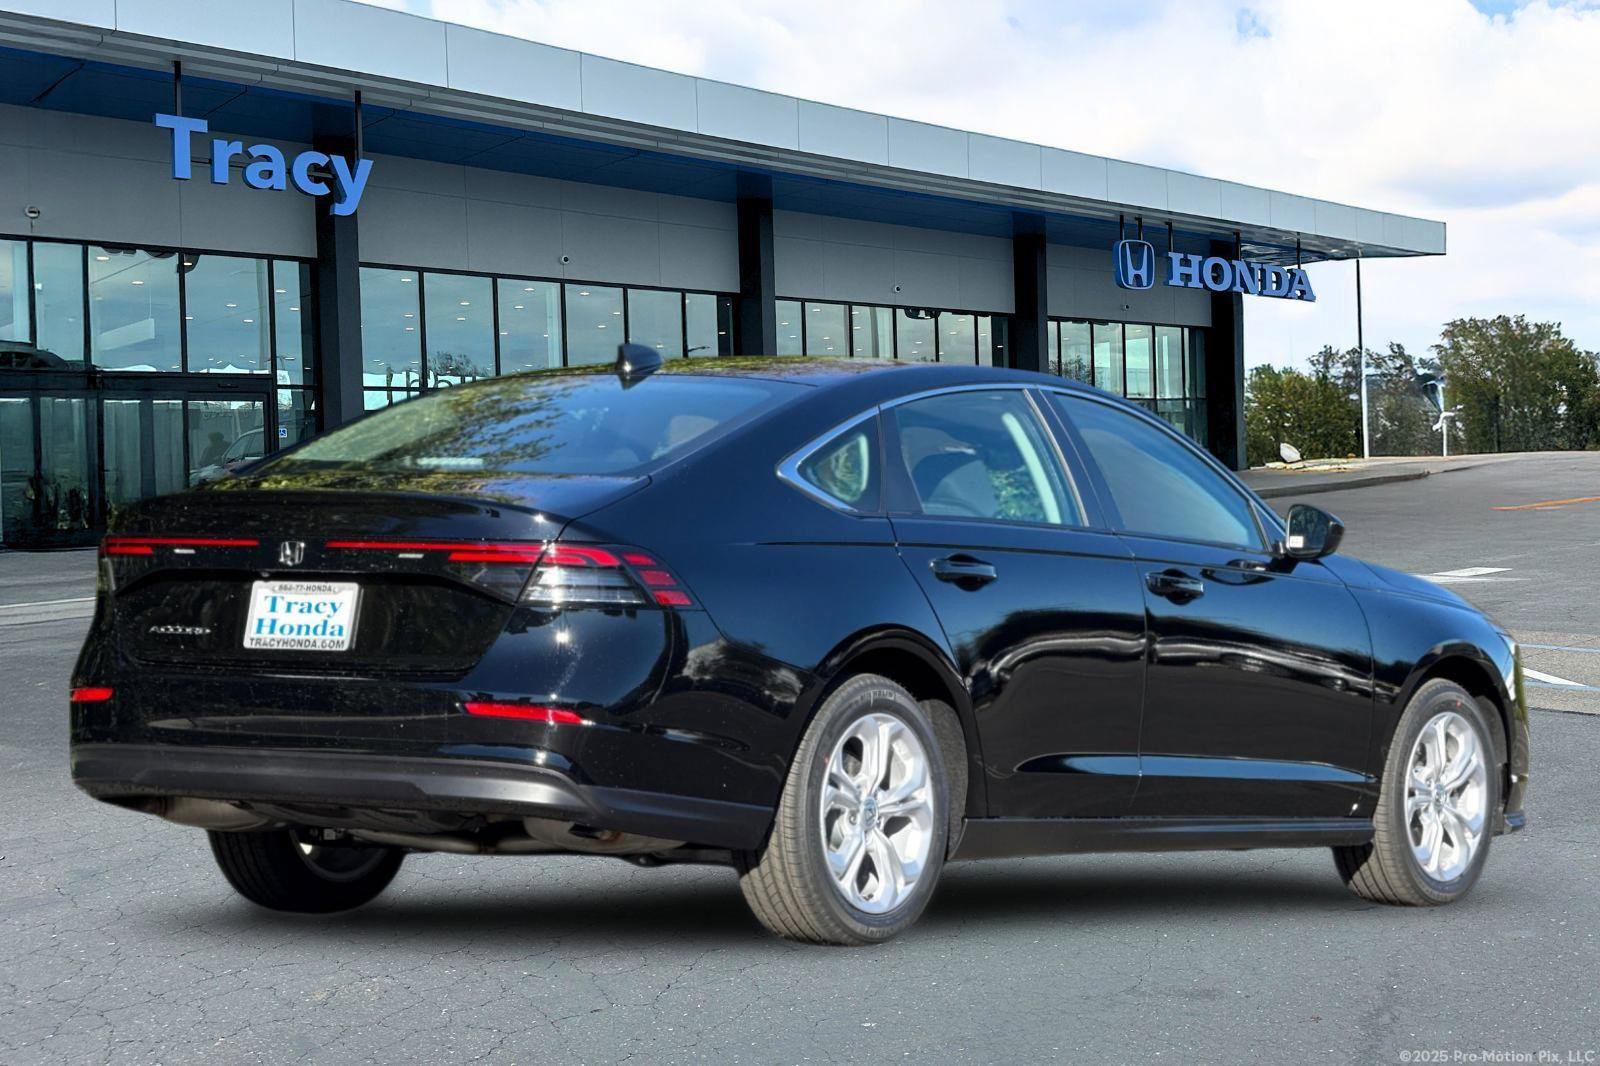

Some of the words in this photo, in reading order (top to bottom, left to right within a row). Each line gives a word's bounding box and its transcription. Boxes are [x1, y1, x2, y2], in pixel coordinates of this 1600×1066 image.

[153, 113, 374, 216] Tracy
[1166, 251, 1317, 302] HONDA
[264, 595, 343, 618] Tracy
[255, 618, 344, 637] Honda
[249, 638, 345, 649] TRACYHONDA.COM
